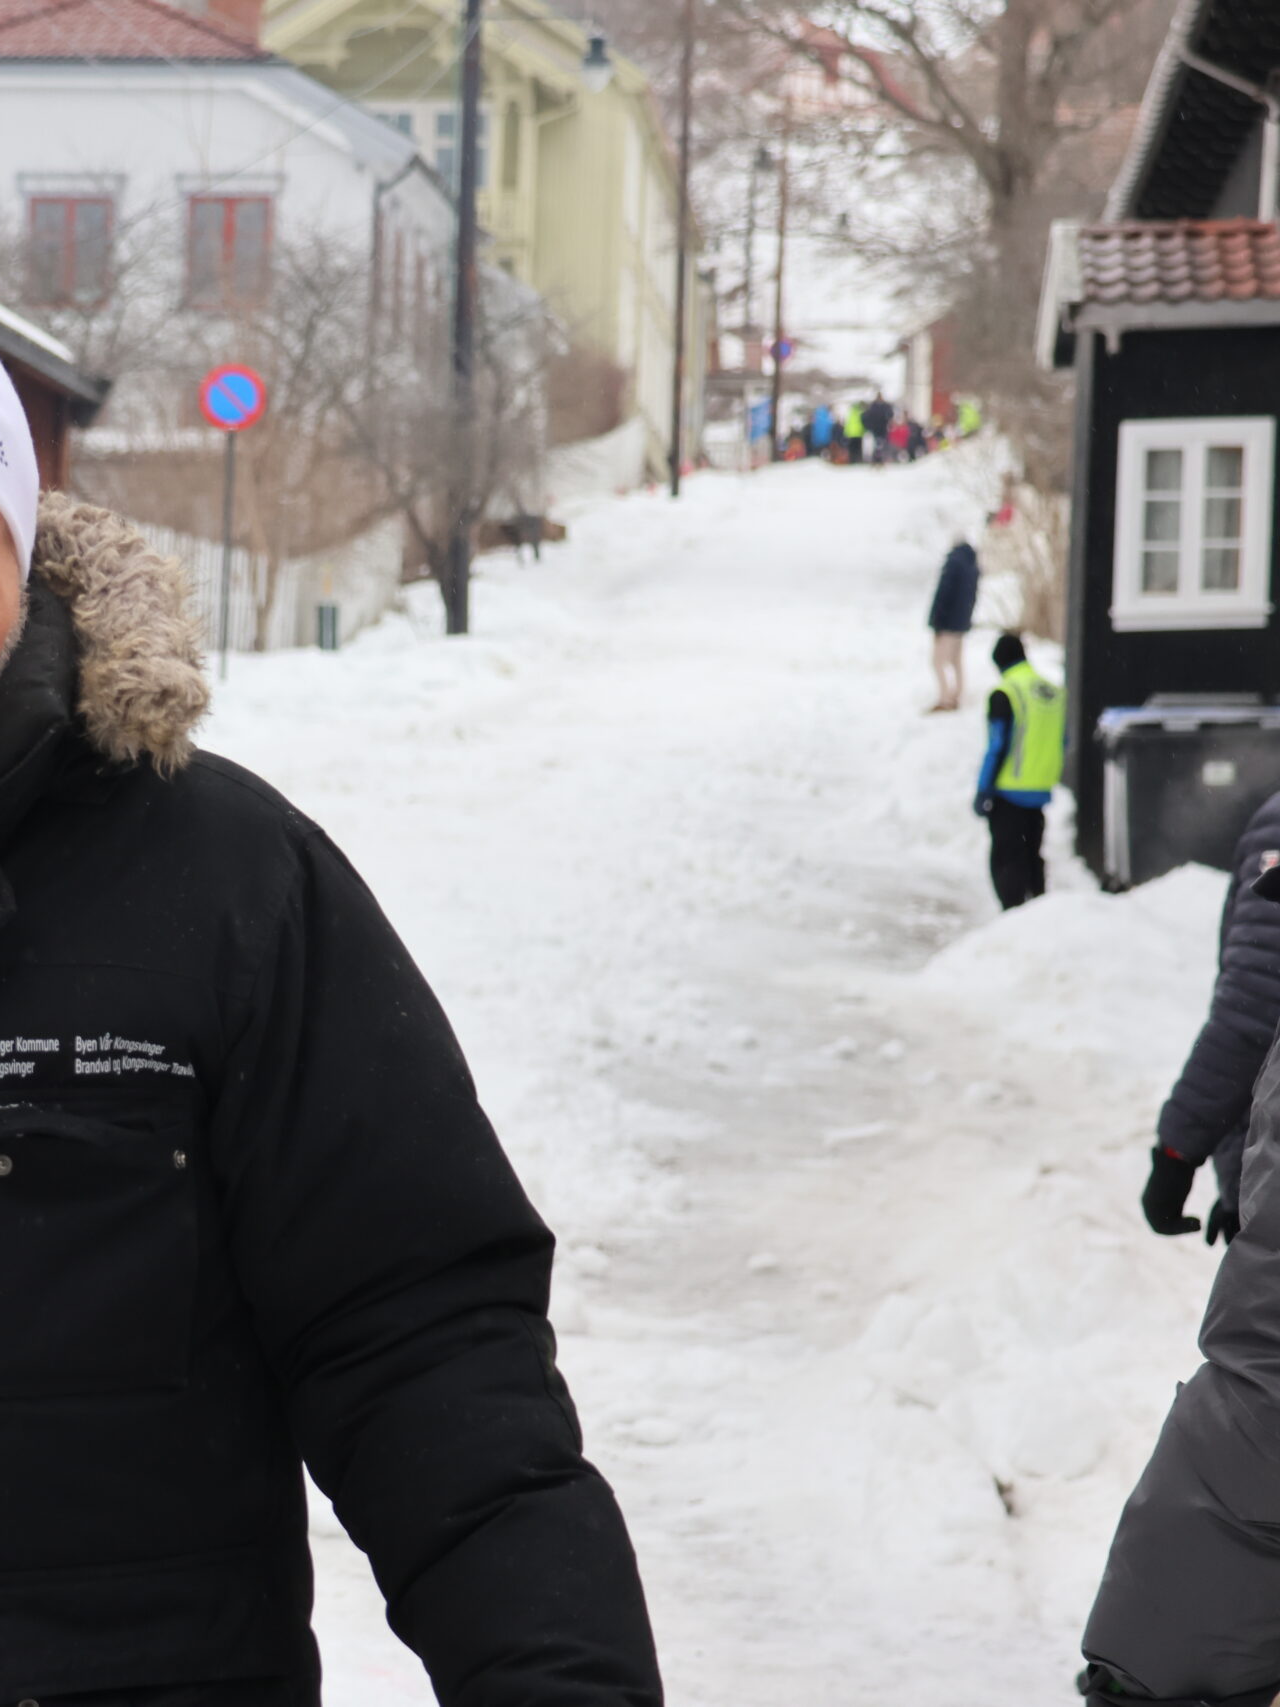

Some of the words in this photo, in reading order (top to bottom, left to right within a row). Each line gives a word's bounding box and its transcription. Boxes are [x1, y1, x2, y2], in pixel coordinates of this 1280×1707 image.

[16, 1036, 60, 1053] Kommune
[75, 1036, 98, 1054] Byen
[99, 1032, 114, 1051] Vår
[113, 1036, 166, 1056] Kongsvinger
[75, 1058, 112, 1074] Brandval
[112, 1060, 122, 1075] og
[122, 1055, 171, 1073] Kongsvinger
